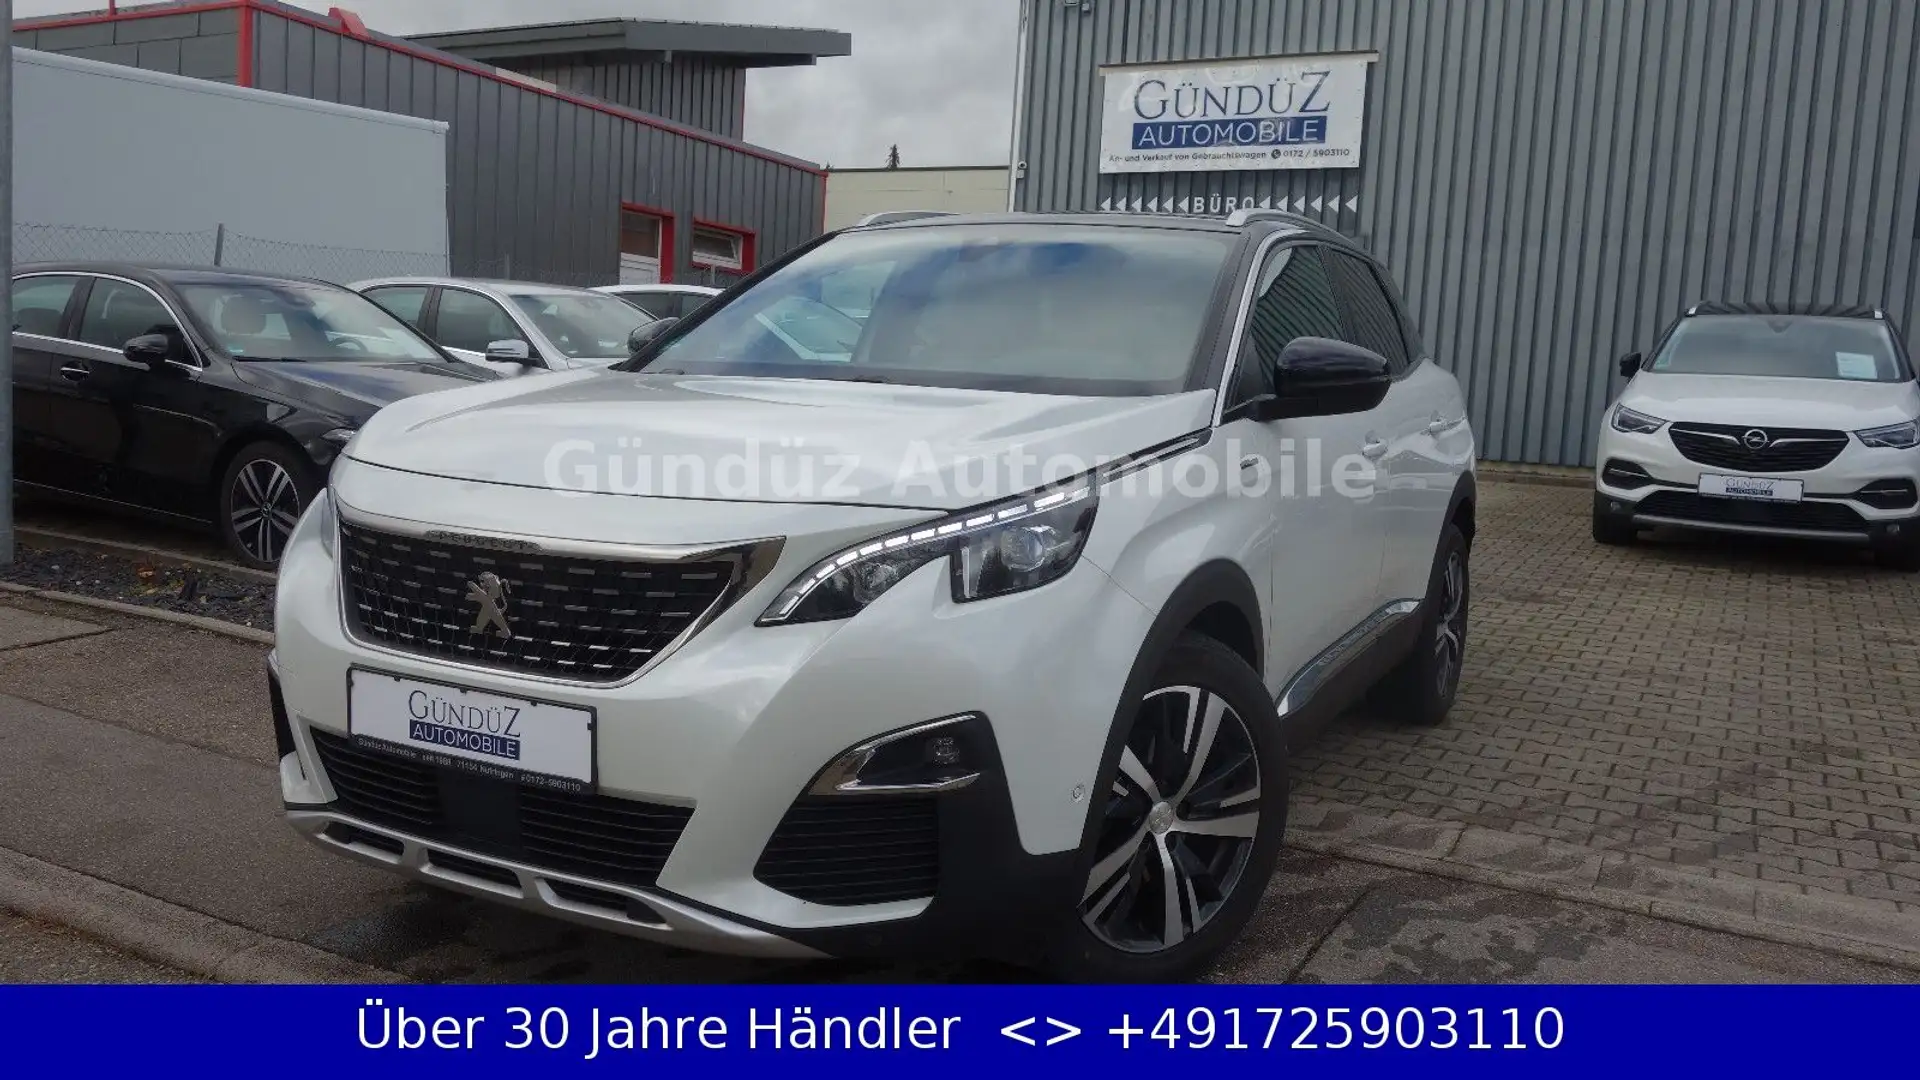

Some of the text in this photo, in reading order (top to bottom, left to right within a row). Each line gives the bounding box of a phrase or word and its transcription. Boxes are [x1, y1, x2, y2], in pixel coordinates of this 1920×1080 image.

[1134, 70, 1331, 120] GÜNDÜZ
[1138, 120, 1319, 146] AUTOMOBILE
[1125, 153, 1139, 162] und
[1142, 152, 1172, 162] Verkauf
[1283, 150, 1303, 158] 0172
[1313, 148, 1350, 157] 5903110
[1193, 193, 1255, 213] BÜRO
[409, 690, 520, 738] GÜNDÜZ
[413, 723, 516, 758] AUTOMOBILE
